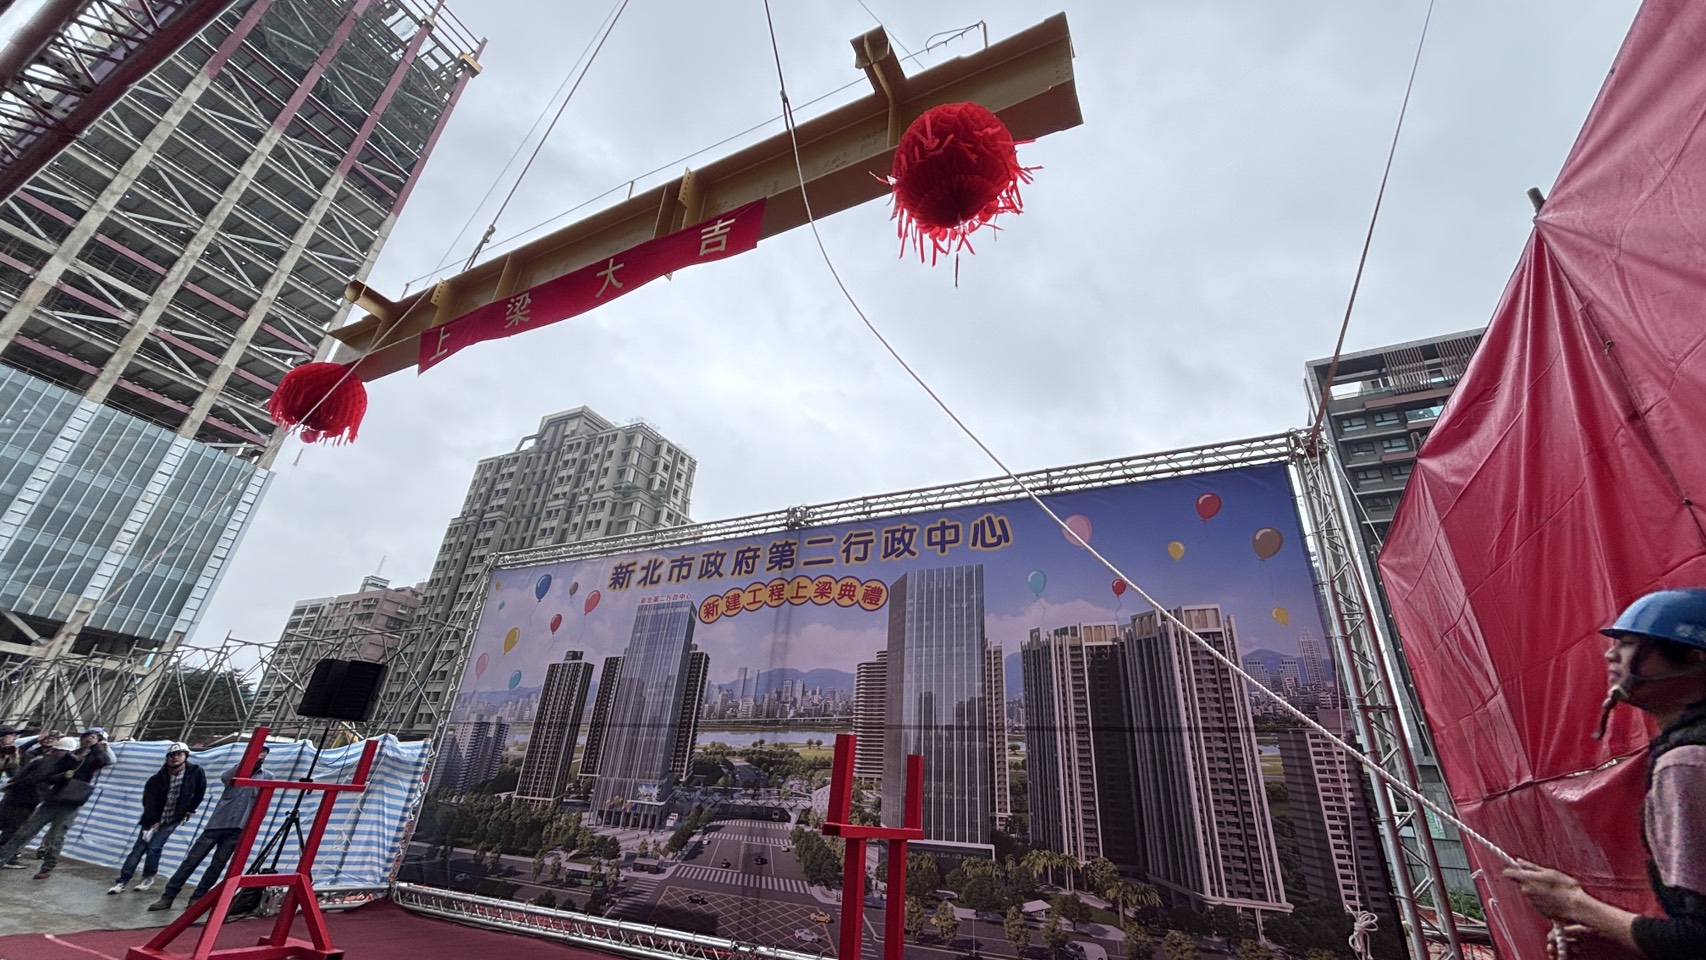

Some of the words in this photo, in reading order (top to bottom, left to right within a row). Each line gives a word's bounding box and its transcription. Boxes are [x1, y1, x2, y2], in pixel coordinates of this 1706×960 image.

[429, 219, 736, 362] 上梁大吉
[607, 513, 1012, 591] 新北市政府第二行政中心
[702, 579, 886, 620] 新建工程上梁典禮
